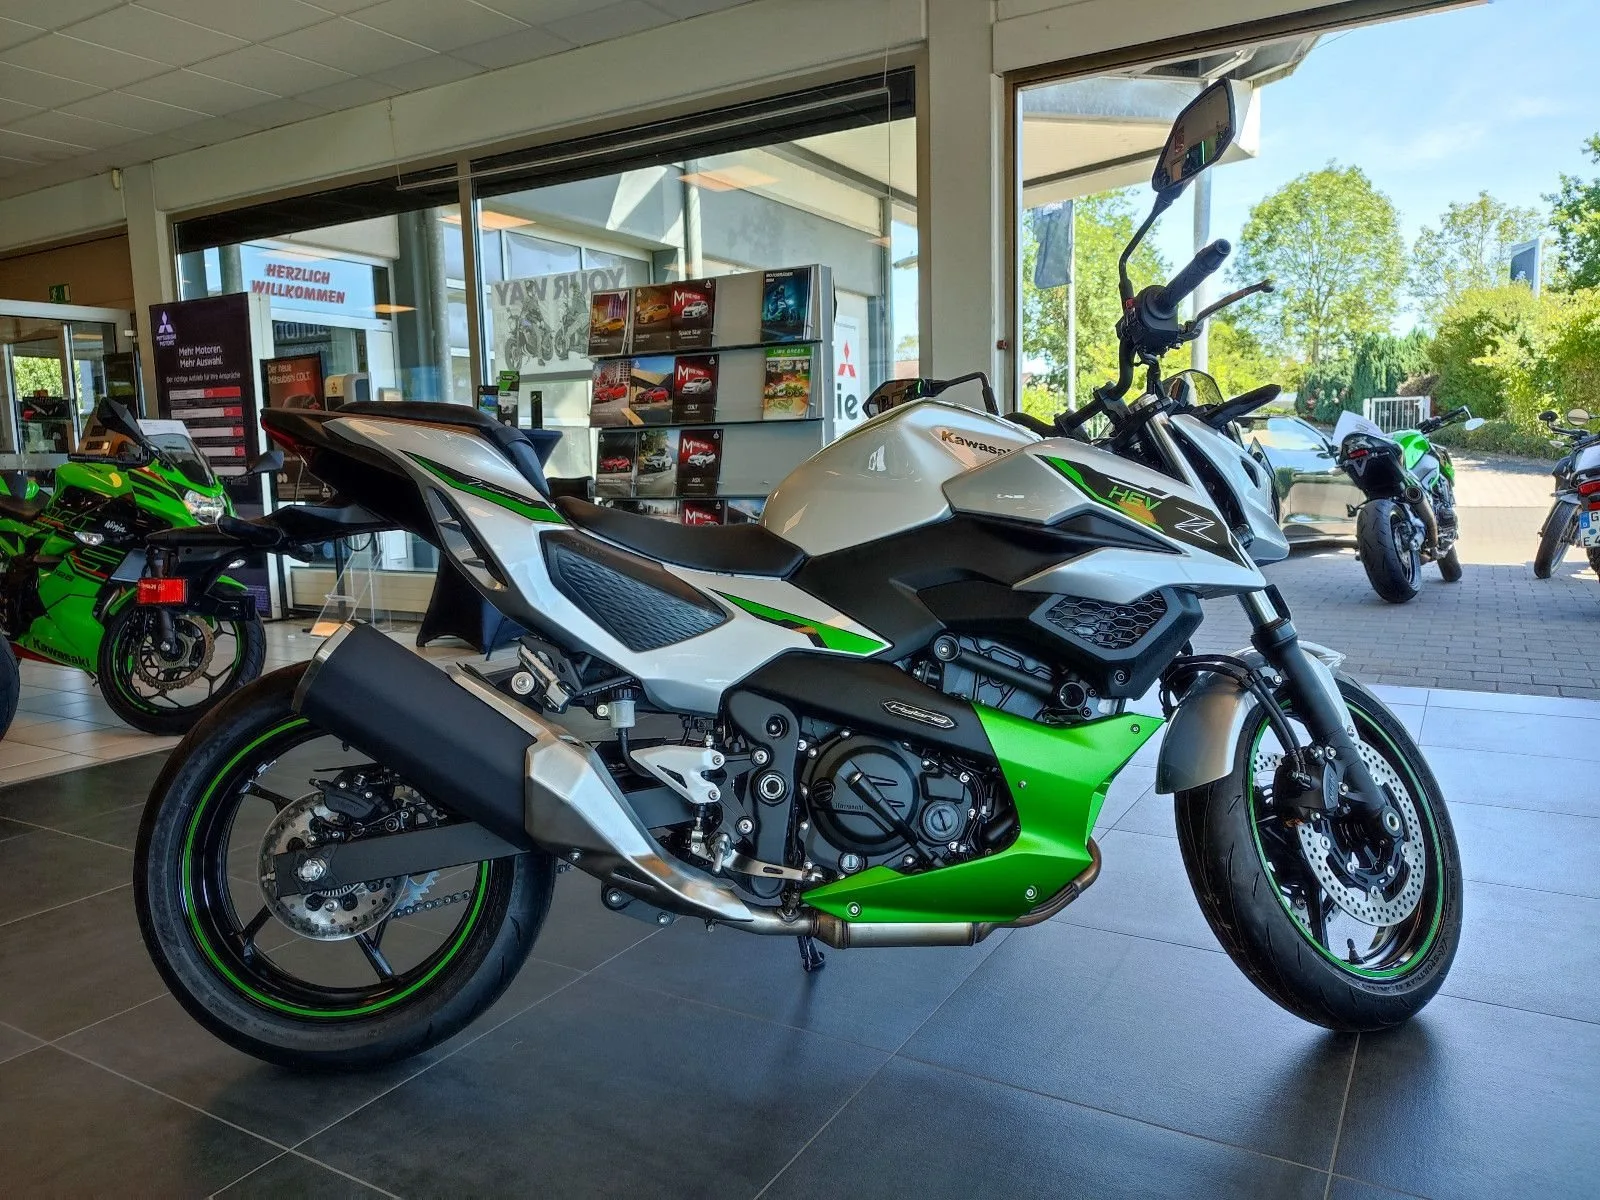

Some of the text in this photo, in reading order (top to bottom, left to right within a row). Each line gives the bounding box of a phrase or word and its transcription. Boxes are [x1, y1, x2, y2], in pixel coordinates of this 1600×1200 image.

[266, 263, 331, 285] HERZLICH
[251, 279, 346, 304] WILLKOMMEN
[178, 347, 194, 356] Mehr
[179, 358, 196, 368] Mehr
[1108, 485, 1162, 511] HEV
[104, 519, 127, 533] Ninja
[32, 636, 91, 668] Kawasaki
